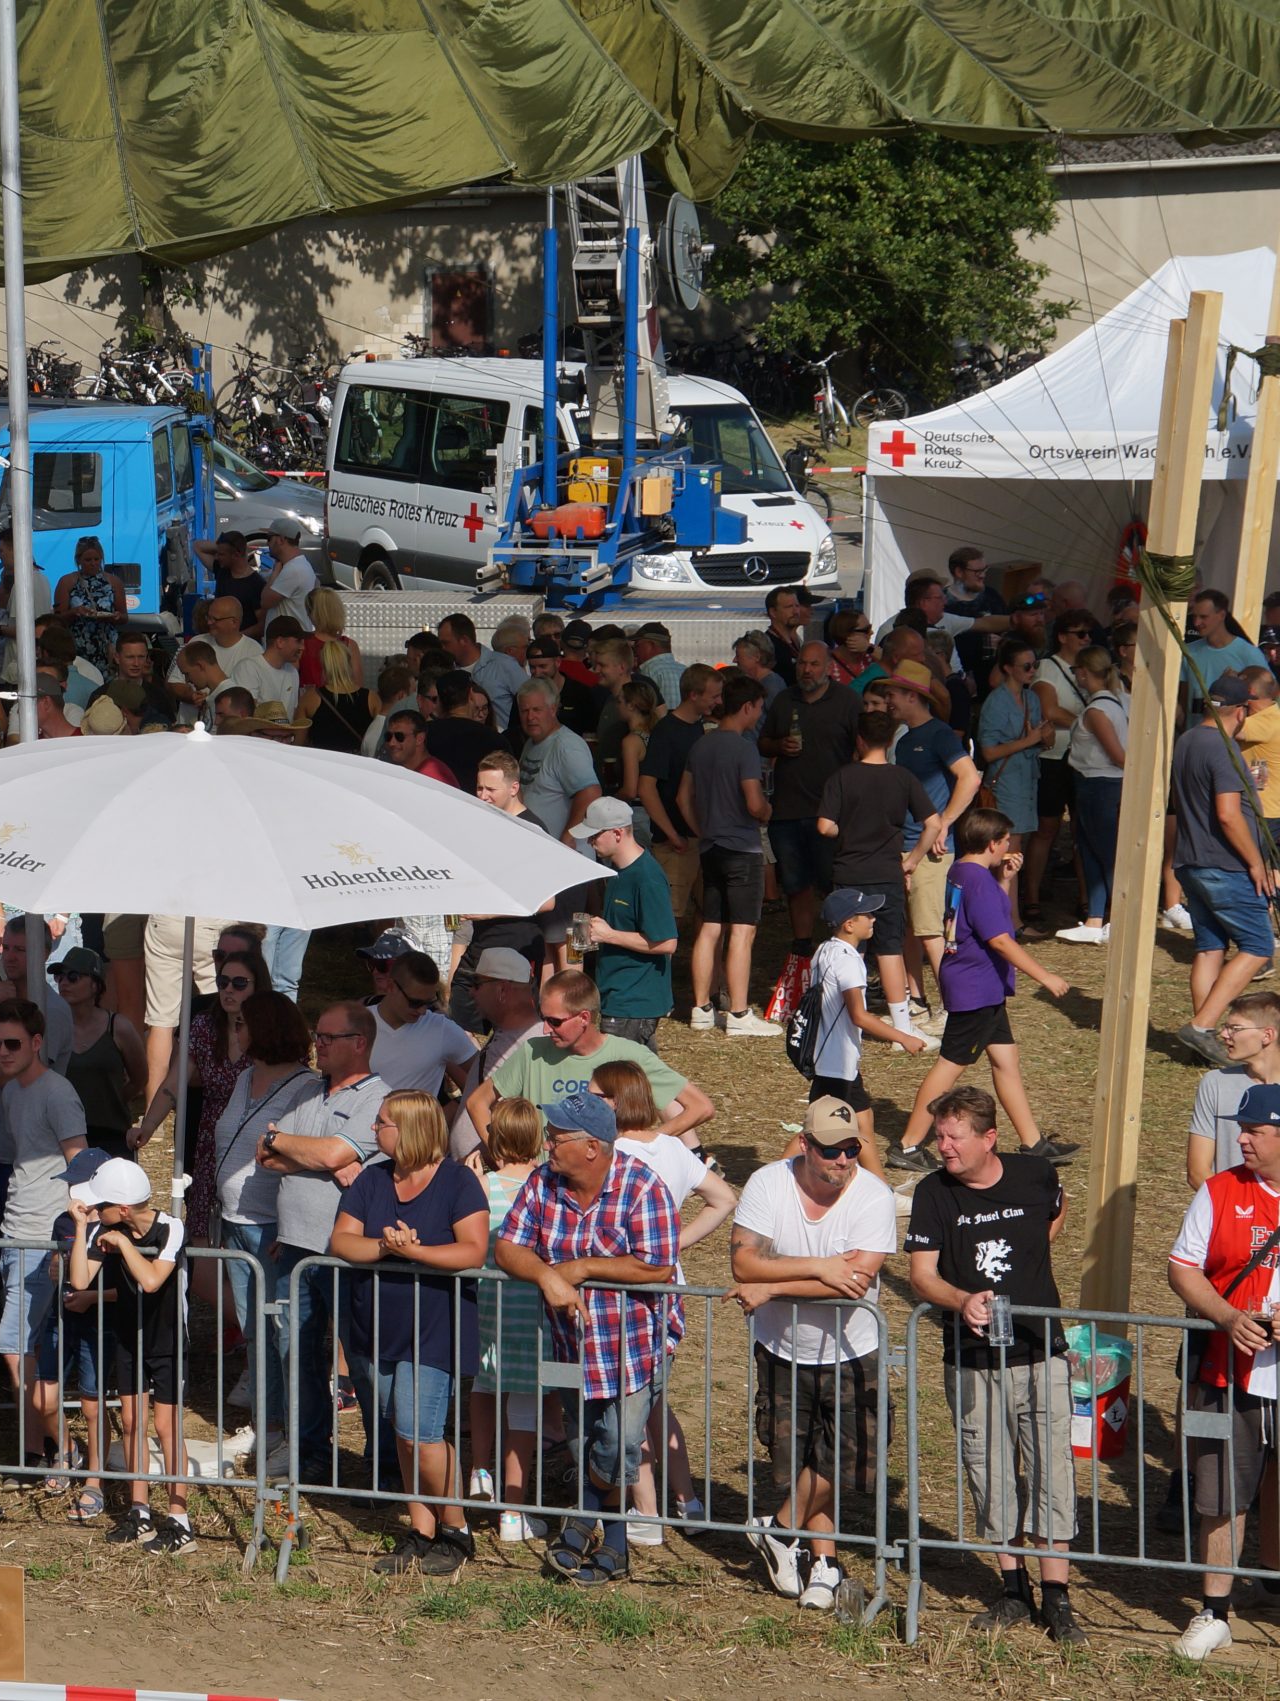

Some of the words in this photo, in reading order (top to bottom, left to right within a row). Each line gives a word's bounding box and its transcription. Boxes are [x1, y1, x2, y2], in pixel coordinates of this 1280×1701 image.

[924, 431, 994, 443] Deutsches
[924, 444, 962, 455] Rotes
[1029, 444, 1117, 459] Ortsverein
[924, 457, 962, 469] Kreuz
[330, 489, 387, 517] Deutsches
[389, 499, 421, 522] Rotes
[424, 505, 460, 528] Kreuz
[302, 865, 455, 889] Hohenfelder
[974, 1211, 1000, 1225] Fusel
[1002, 1208, 1025, 1219] Clan
